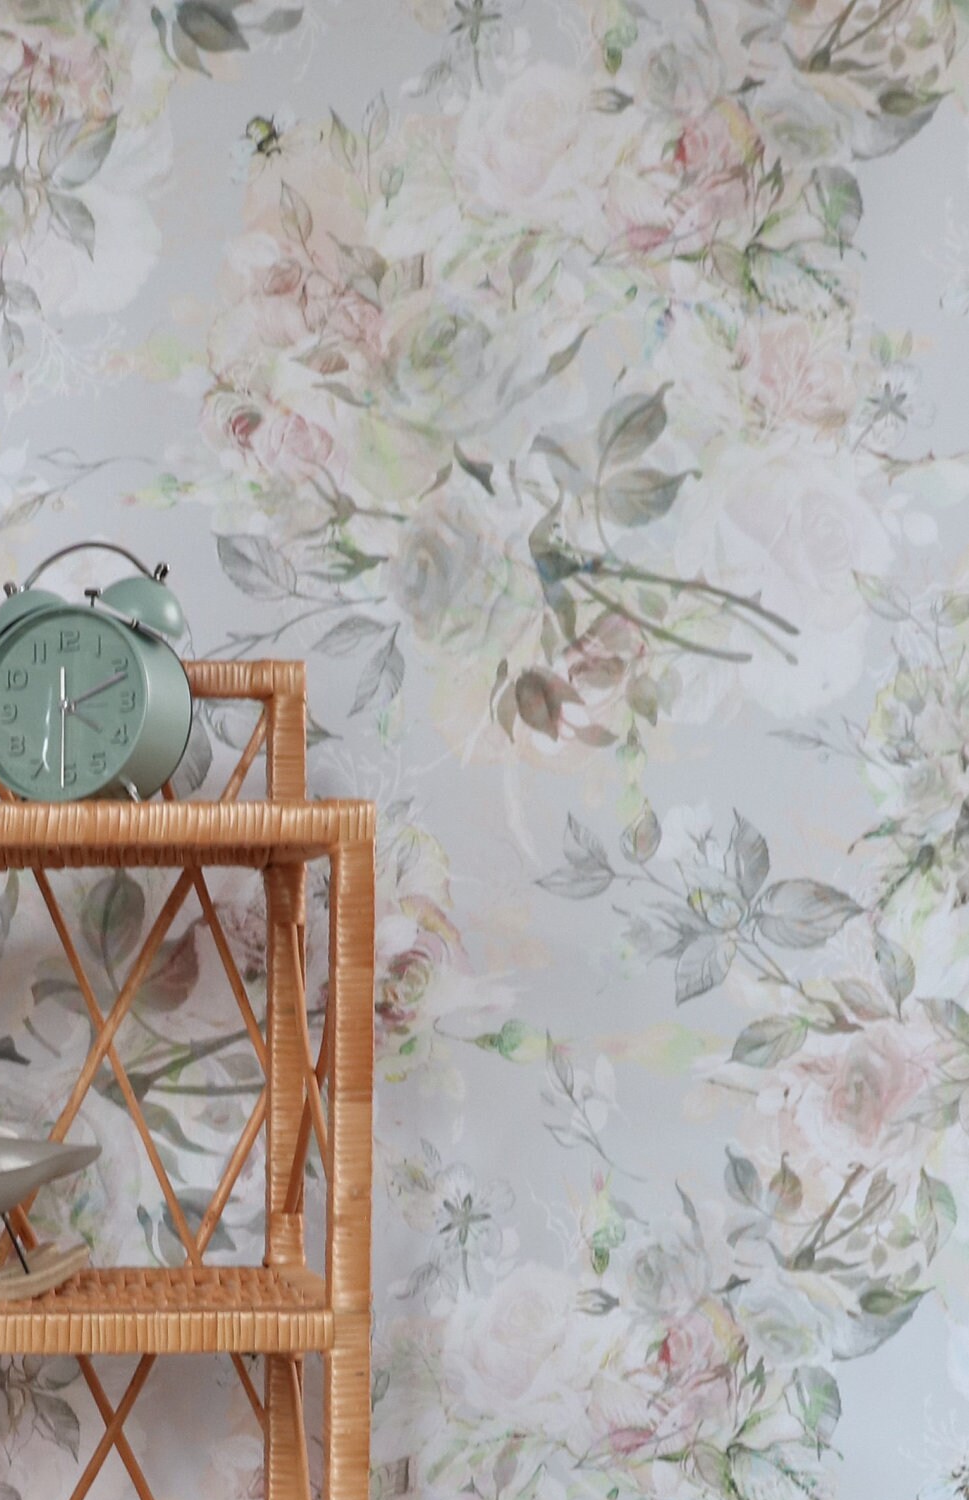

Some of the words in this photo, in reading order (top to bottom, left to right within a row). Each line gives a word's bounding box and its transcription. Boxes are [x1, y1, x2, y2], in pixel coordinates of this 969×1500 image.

[58, 630, 81, 653] 12
[95, 634, 102, 658] 1
[32, 642, 47, 664] 11
[111, 657, 129, 675] 2
[7, 668, 29, 690] 10
[120, 691, 136, 713] 3
[2, 703, 18, 724] 9
[9, 735, 25, 757] 8
[111, 724, 129, 746] 4
[29, 759, 45, 780] 7
[63, 763, 77, 785] 6
[91, 752, 107, 775] 5
